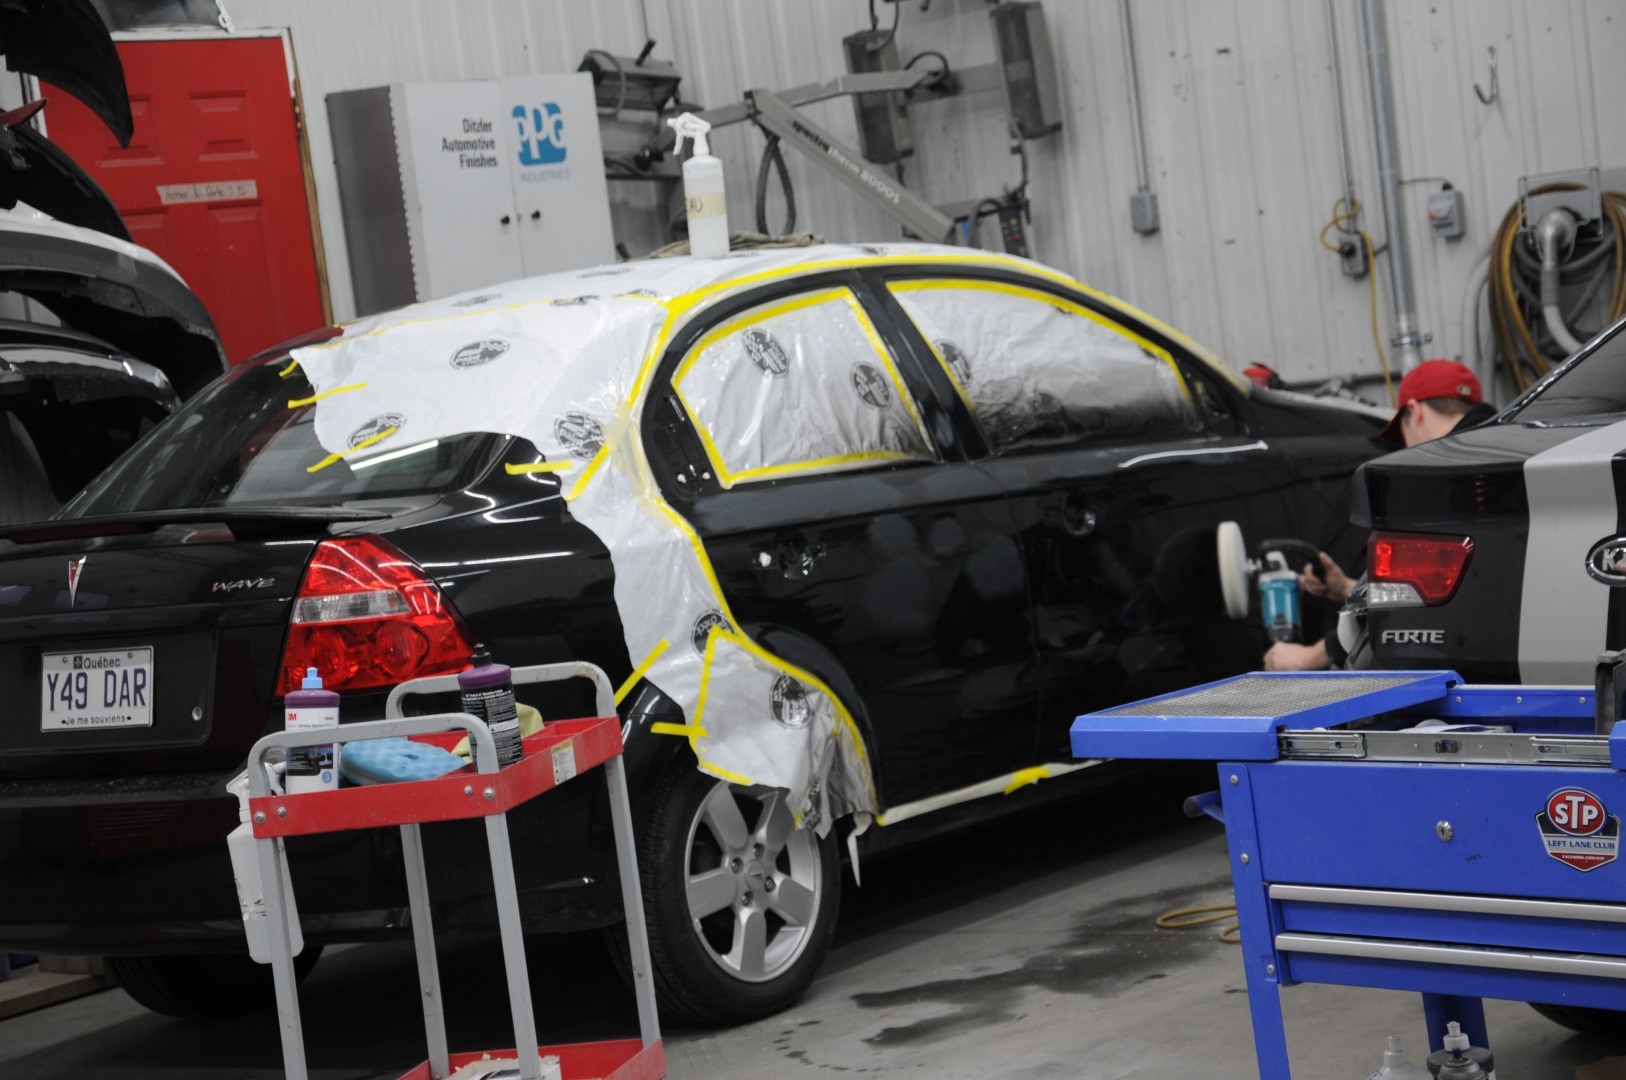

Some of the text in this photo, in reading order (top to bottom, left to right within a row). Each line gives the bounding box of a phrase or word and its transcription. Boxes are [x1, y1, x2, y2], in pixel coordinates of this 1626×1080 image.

[462, 118, 493, 134] Ditzler
[441, 136, 496, 152] Automotive
[459, 153, 498, 169] Finishes
[520, 168, 571, 184] INDUSTRIES
[211, 577, 275, 592] WAVE
[1381, 629, 1445, 644] FORTE
[83, 656, 121, 669] Québec
[47, 667, 147, 711] Y49 DAR
[65, 715, 126, 725] Je me souviens
[287, 713, 297, 721] 3M
[1554, 795, 1599, 829] STP
[1547, 840, 1616, 850] LEFT LANE CLUB
